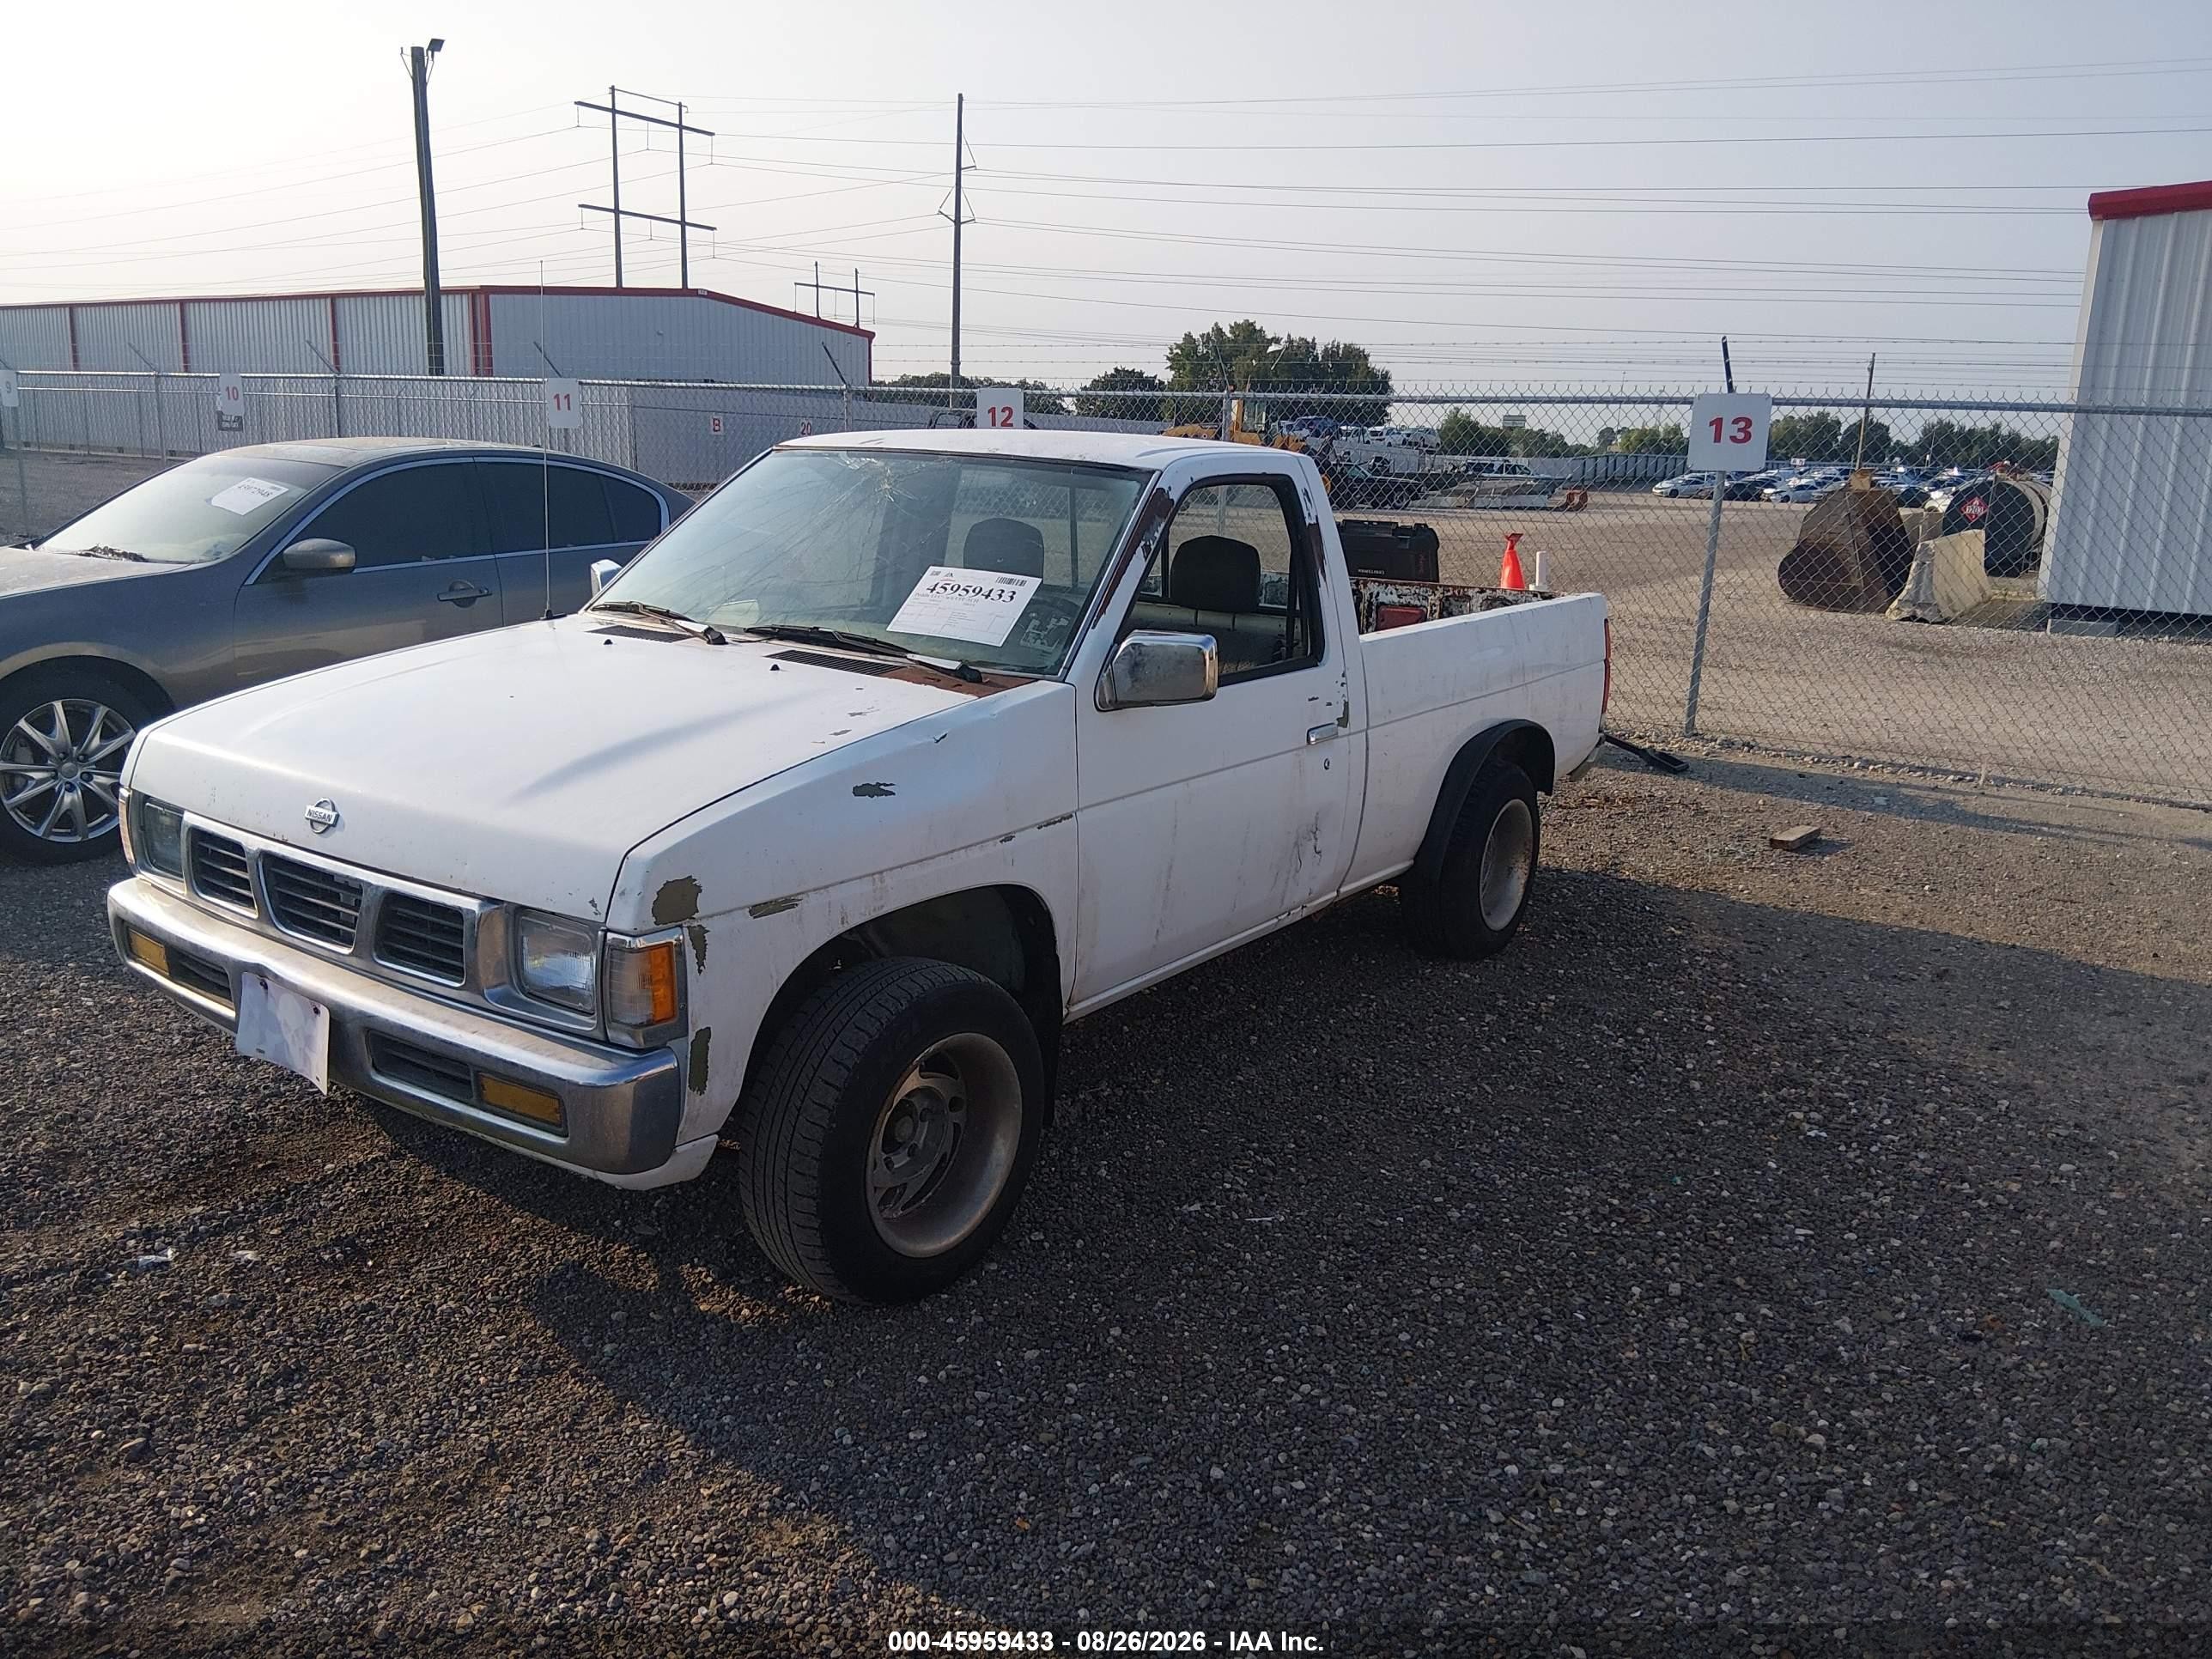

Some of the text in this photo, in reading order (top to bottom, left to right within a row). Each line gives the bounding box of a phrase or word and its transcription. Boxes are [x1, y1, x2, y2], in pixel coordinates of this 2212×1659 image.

[225, 386, 239, 400] 10
[553, 393, 571, 410] 11
[988, 406, 1014, 428] 12
[800, 422, 812, 435] 20
[1709, 416, 1753, 444] 13
[926, 581, 1017, 603] 45959433
[307, 808, 333, 823] NISSAN
